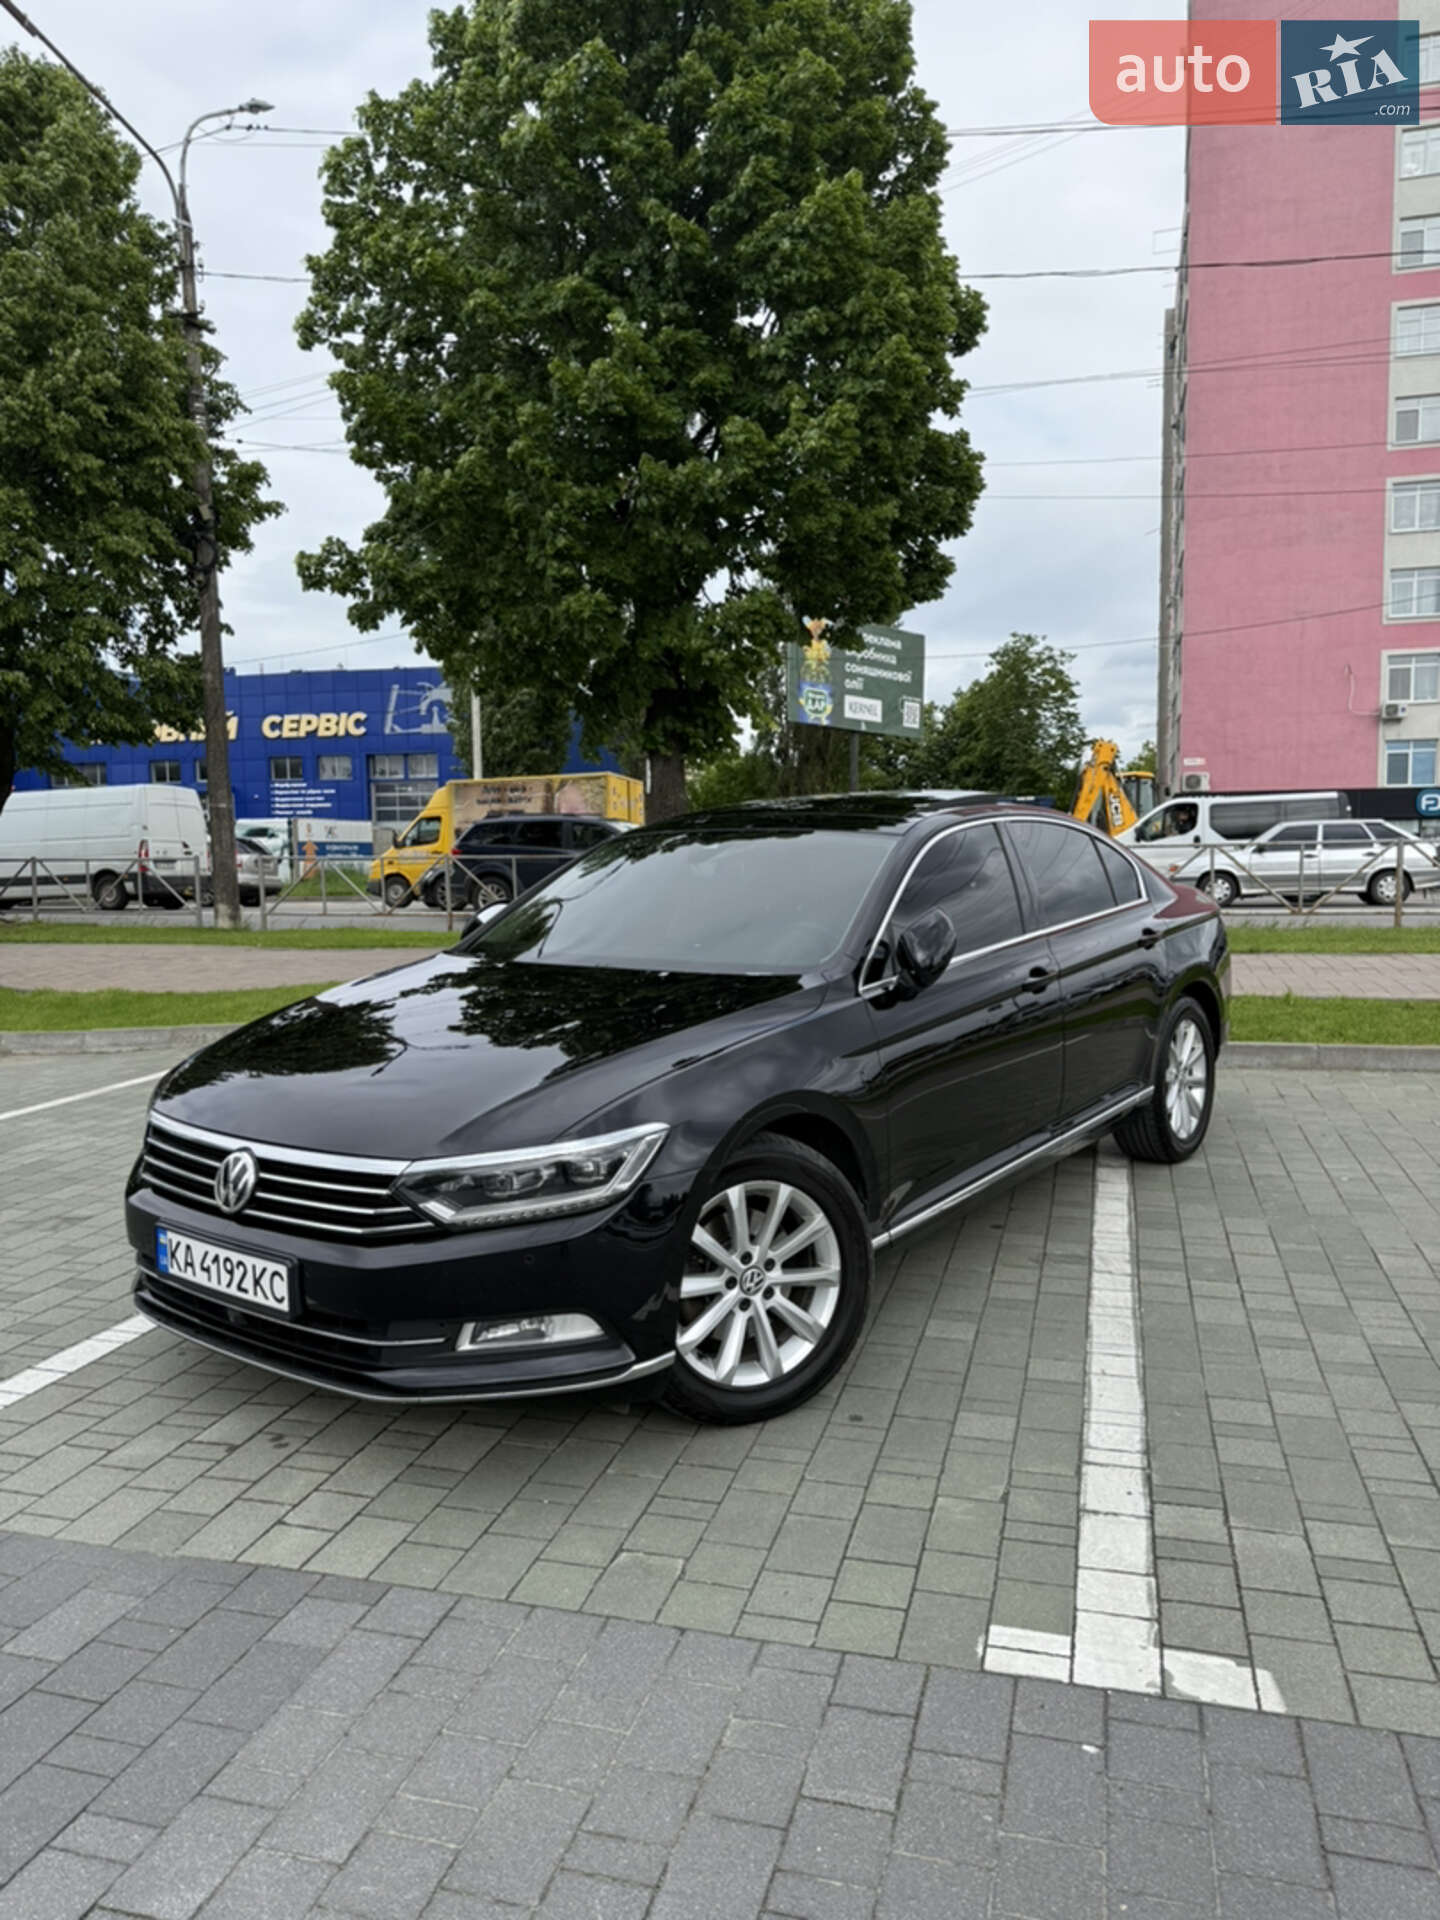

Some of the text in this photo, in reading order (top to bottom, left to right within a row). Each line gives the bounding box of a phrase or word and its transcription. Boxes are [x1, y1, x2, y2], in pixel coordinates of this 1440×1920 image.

[848, 702, 879, 717] KERNEL
[261, 711, 368, 739] СЕРВІС
[1109, 793, 1123, 826] JCB
[168, 1238, 286, 1304] KA4192KC
